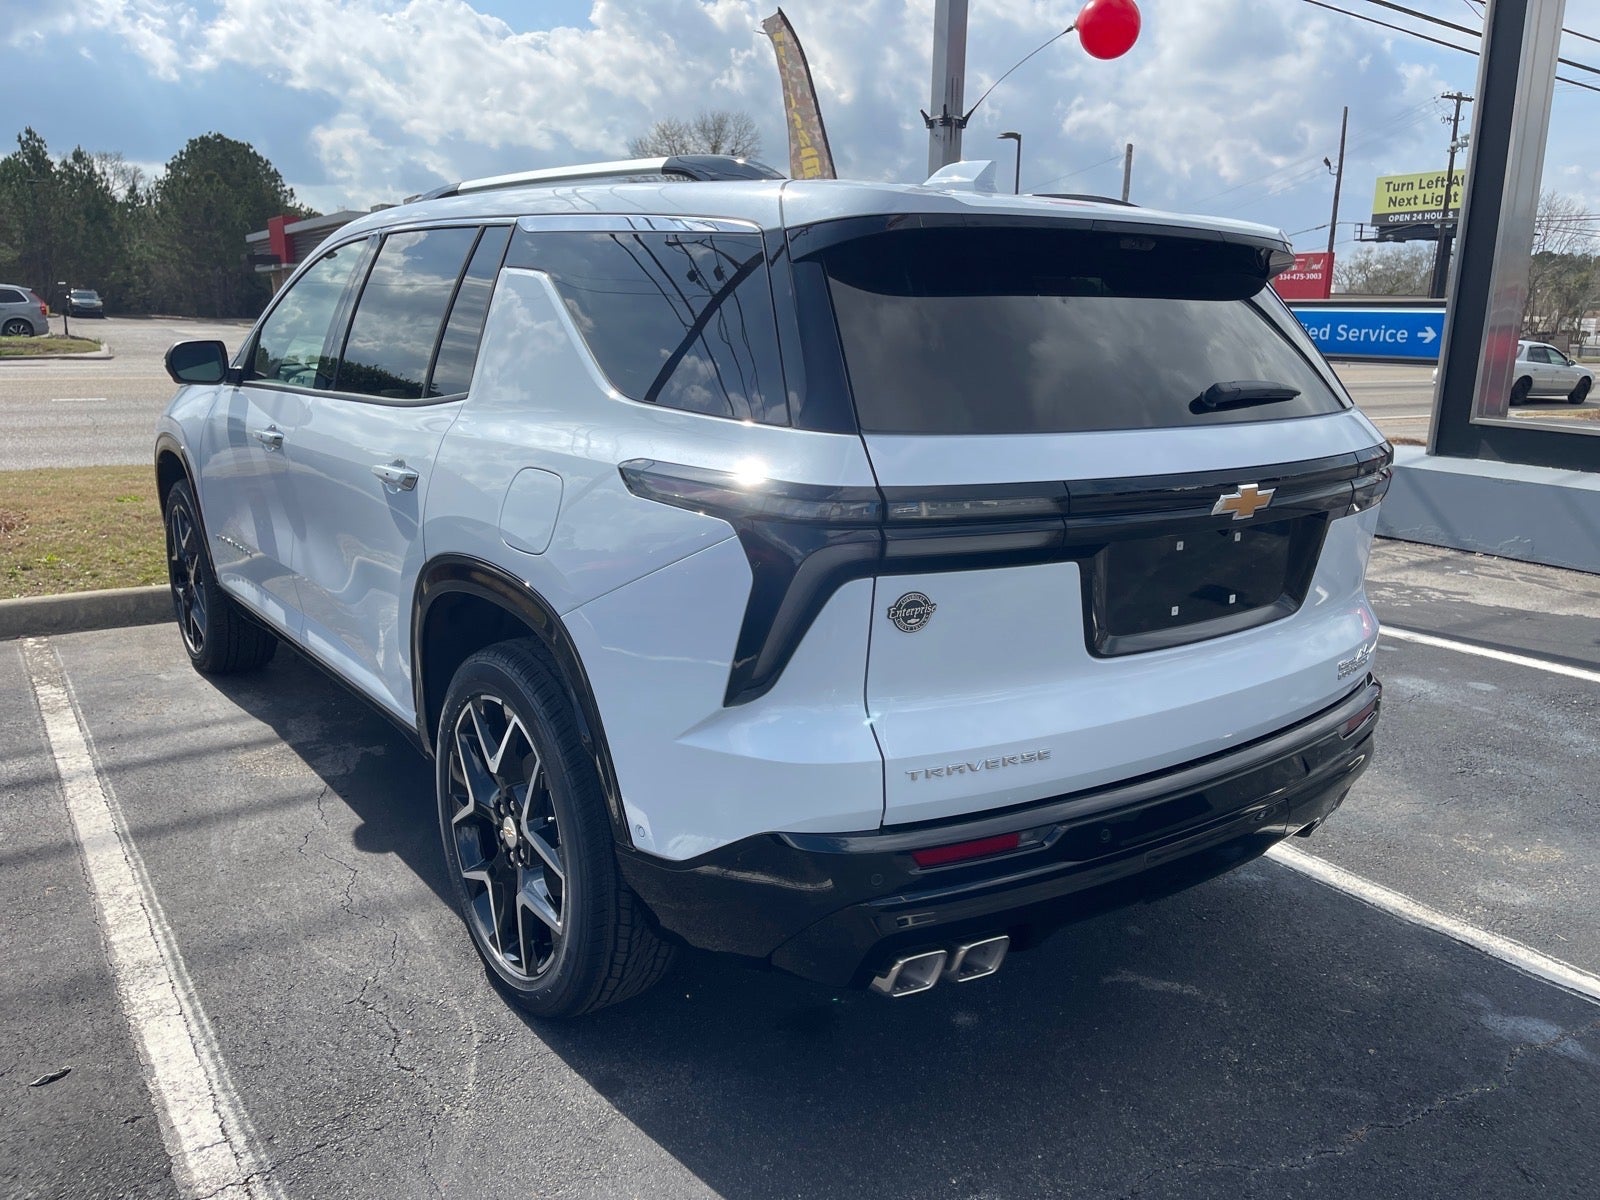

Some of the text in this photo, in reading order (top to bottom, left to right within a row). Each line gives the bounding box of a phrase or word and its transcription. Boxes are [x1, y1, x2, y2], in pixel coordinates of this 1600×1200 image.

[1385, 181, 1414, 192] Turn
[1418, 176, 1446, 189] Left
[1388, 192, 1459, 208] Next Ligt
[1388, 213, 1410, 222] OPEN
[1424, 211, 1454, 220] HOUS
[1303, 323, 1409, 343] ied Service
[889, 603, 937, 619] Enterprise
[905, 748, 1052, 781] TRAVERSE
